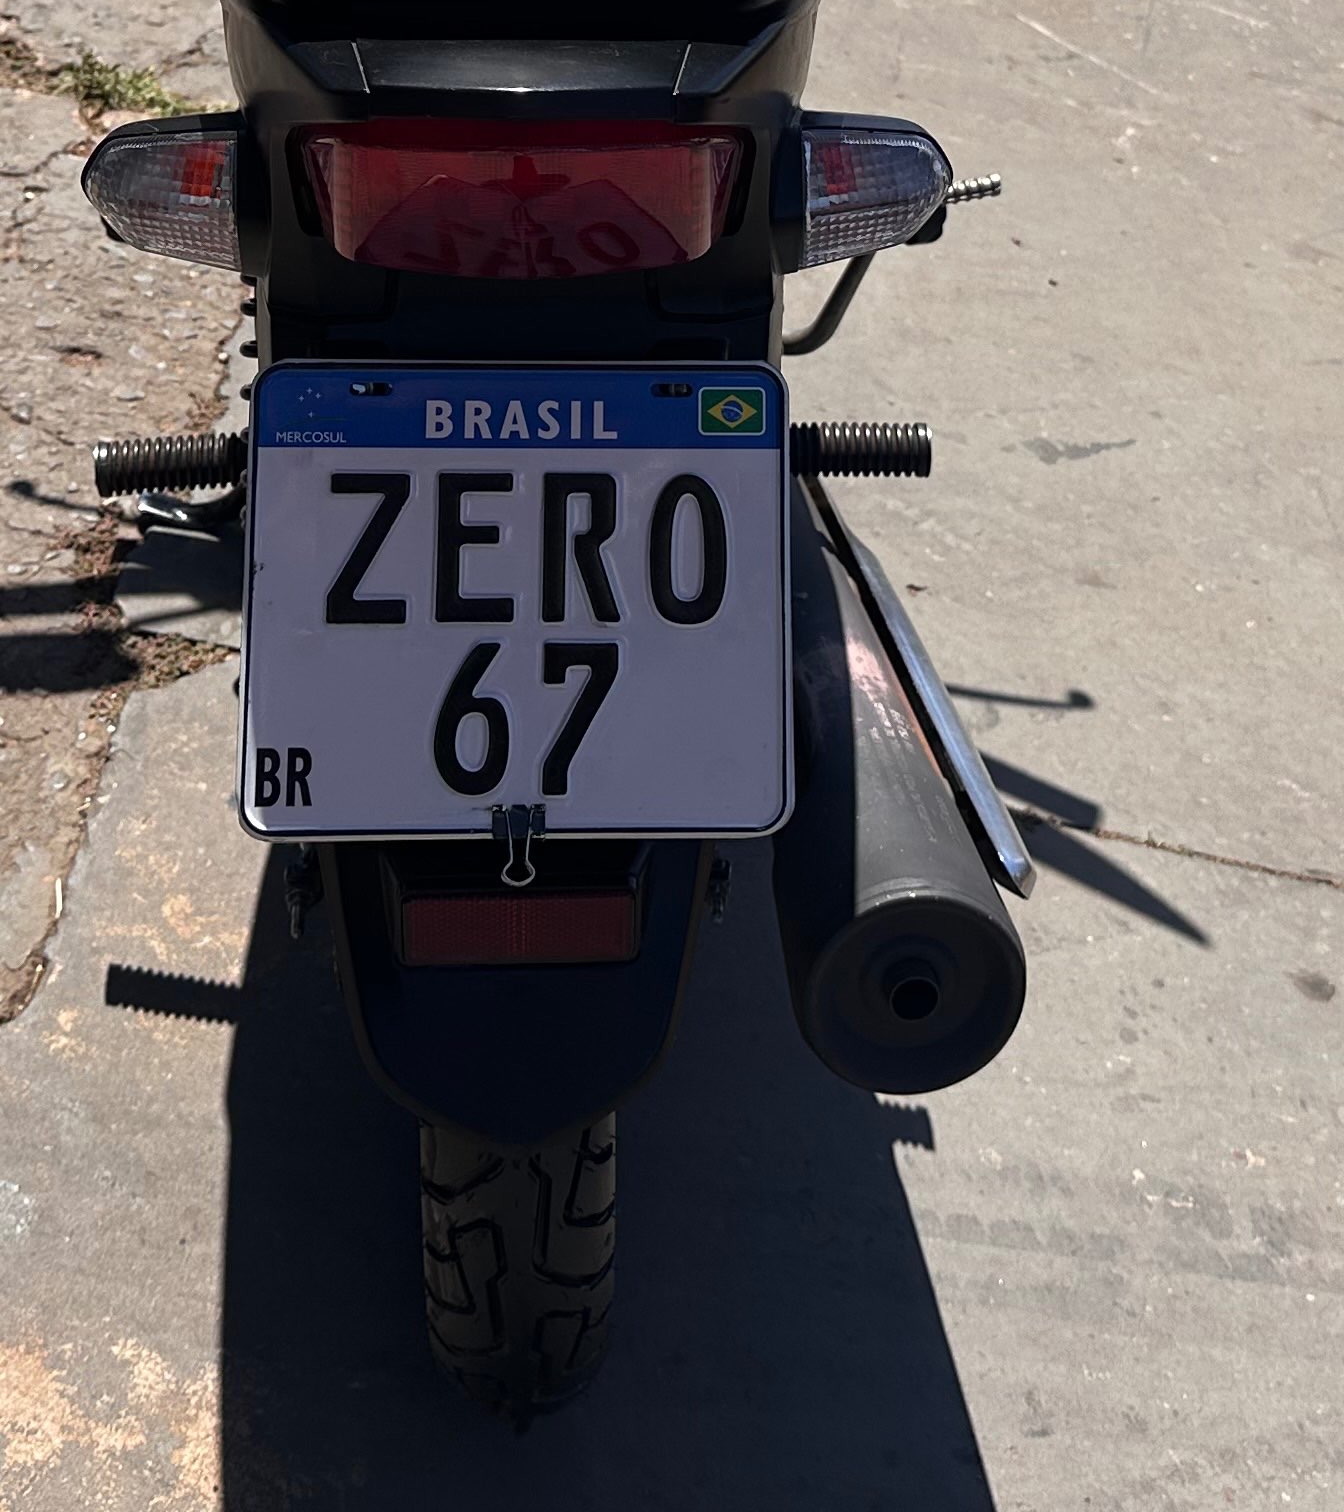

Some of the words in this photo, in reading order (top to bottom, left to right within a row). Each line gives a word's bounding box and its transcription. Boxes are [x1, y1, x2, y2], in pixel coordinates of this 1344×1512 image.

[275, 431, 347, 445] MERCOSUL
[424, 399, 618, 440] BRASIL
[326, 472, 728, 626] ZERO
[433, 641, 620, 796] 67
[254, 746, 313, 808] BR
